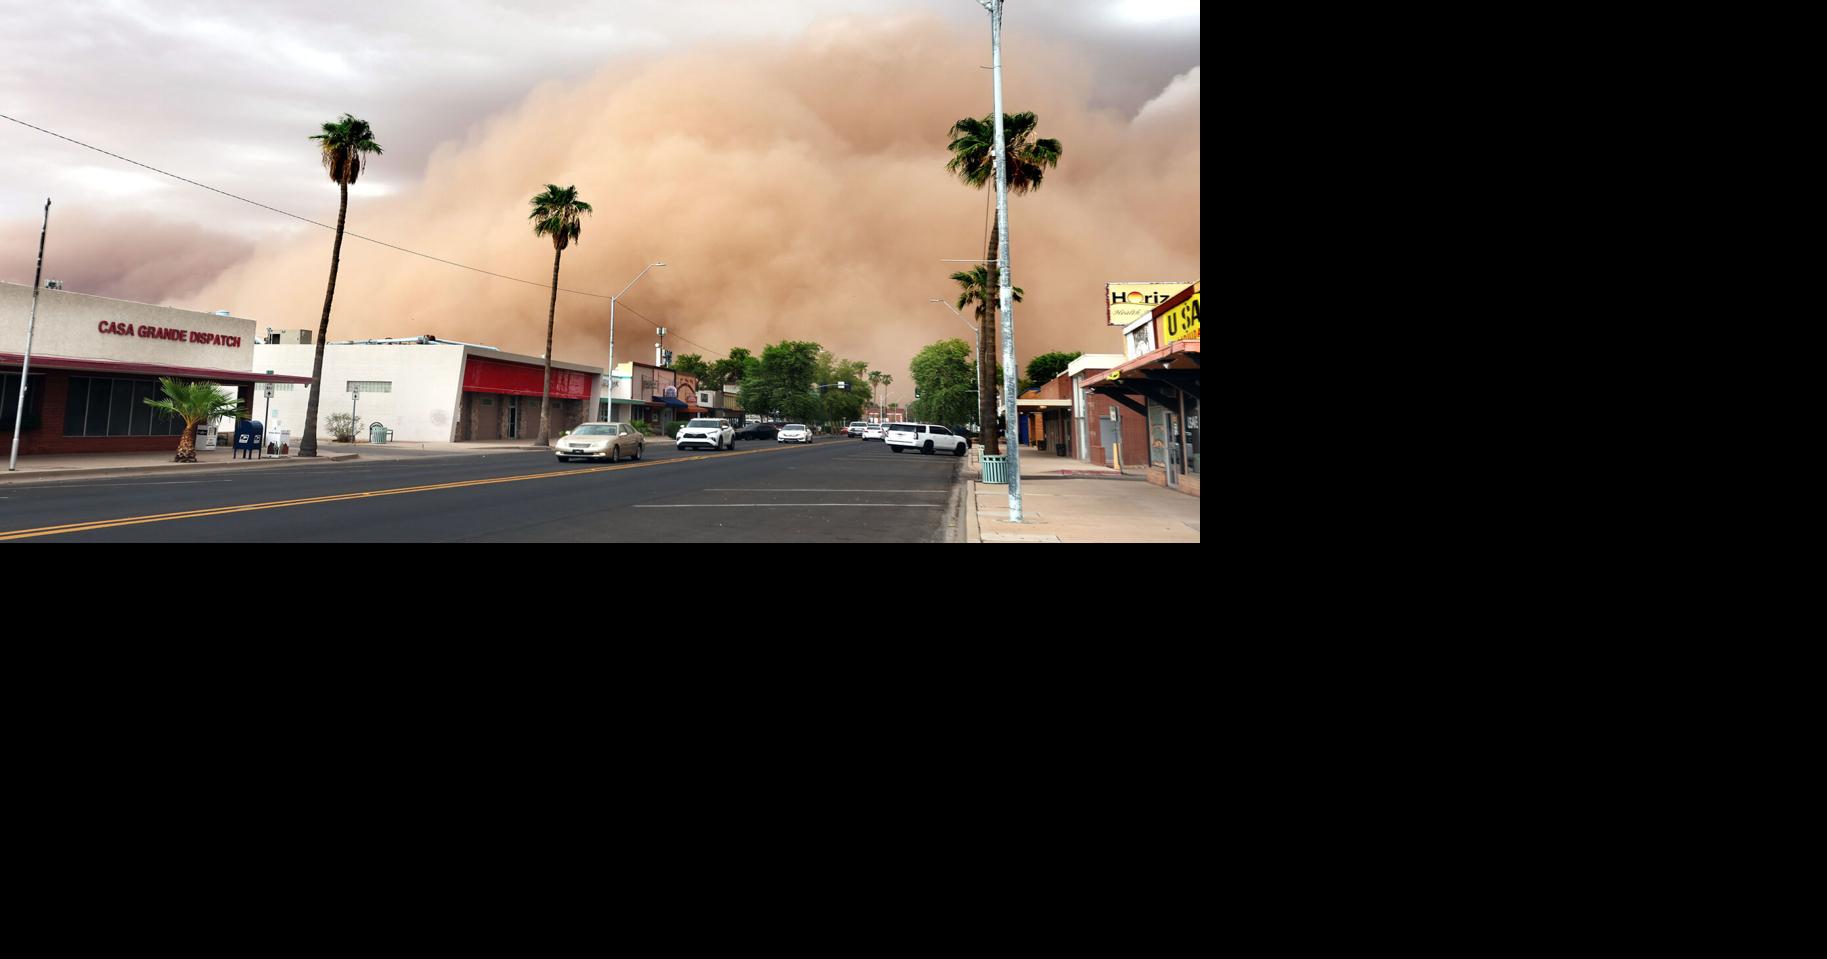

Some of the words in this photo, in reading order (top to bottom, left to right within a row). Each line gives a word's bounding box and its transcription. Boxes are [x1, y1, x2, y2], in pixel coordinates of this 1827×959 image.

[98, 320, 135, 337] CASA
[137, 324, 187, 342] GRANDE
[189, 330, 241, 348] DISPATCH
[1168, 312, 1177, 336] U
